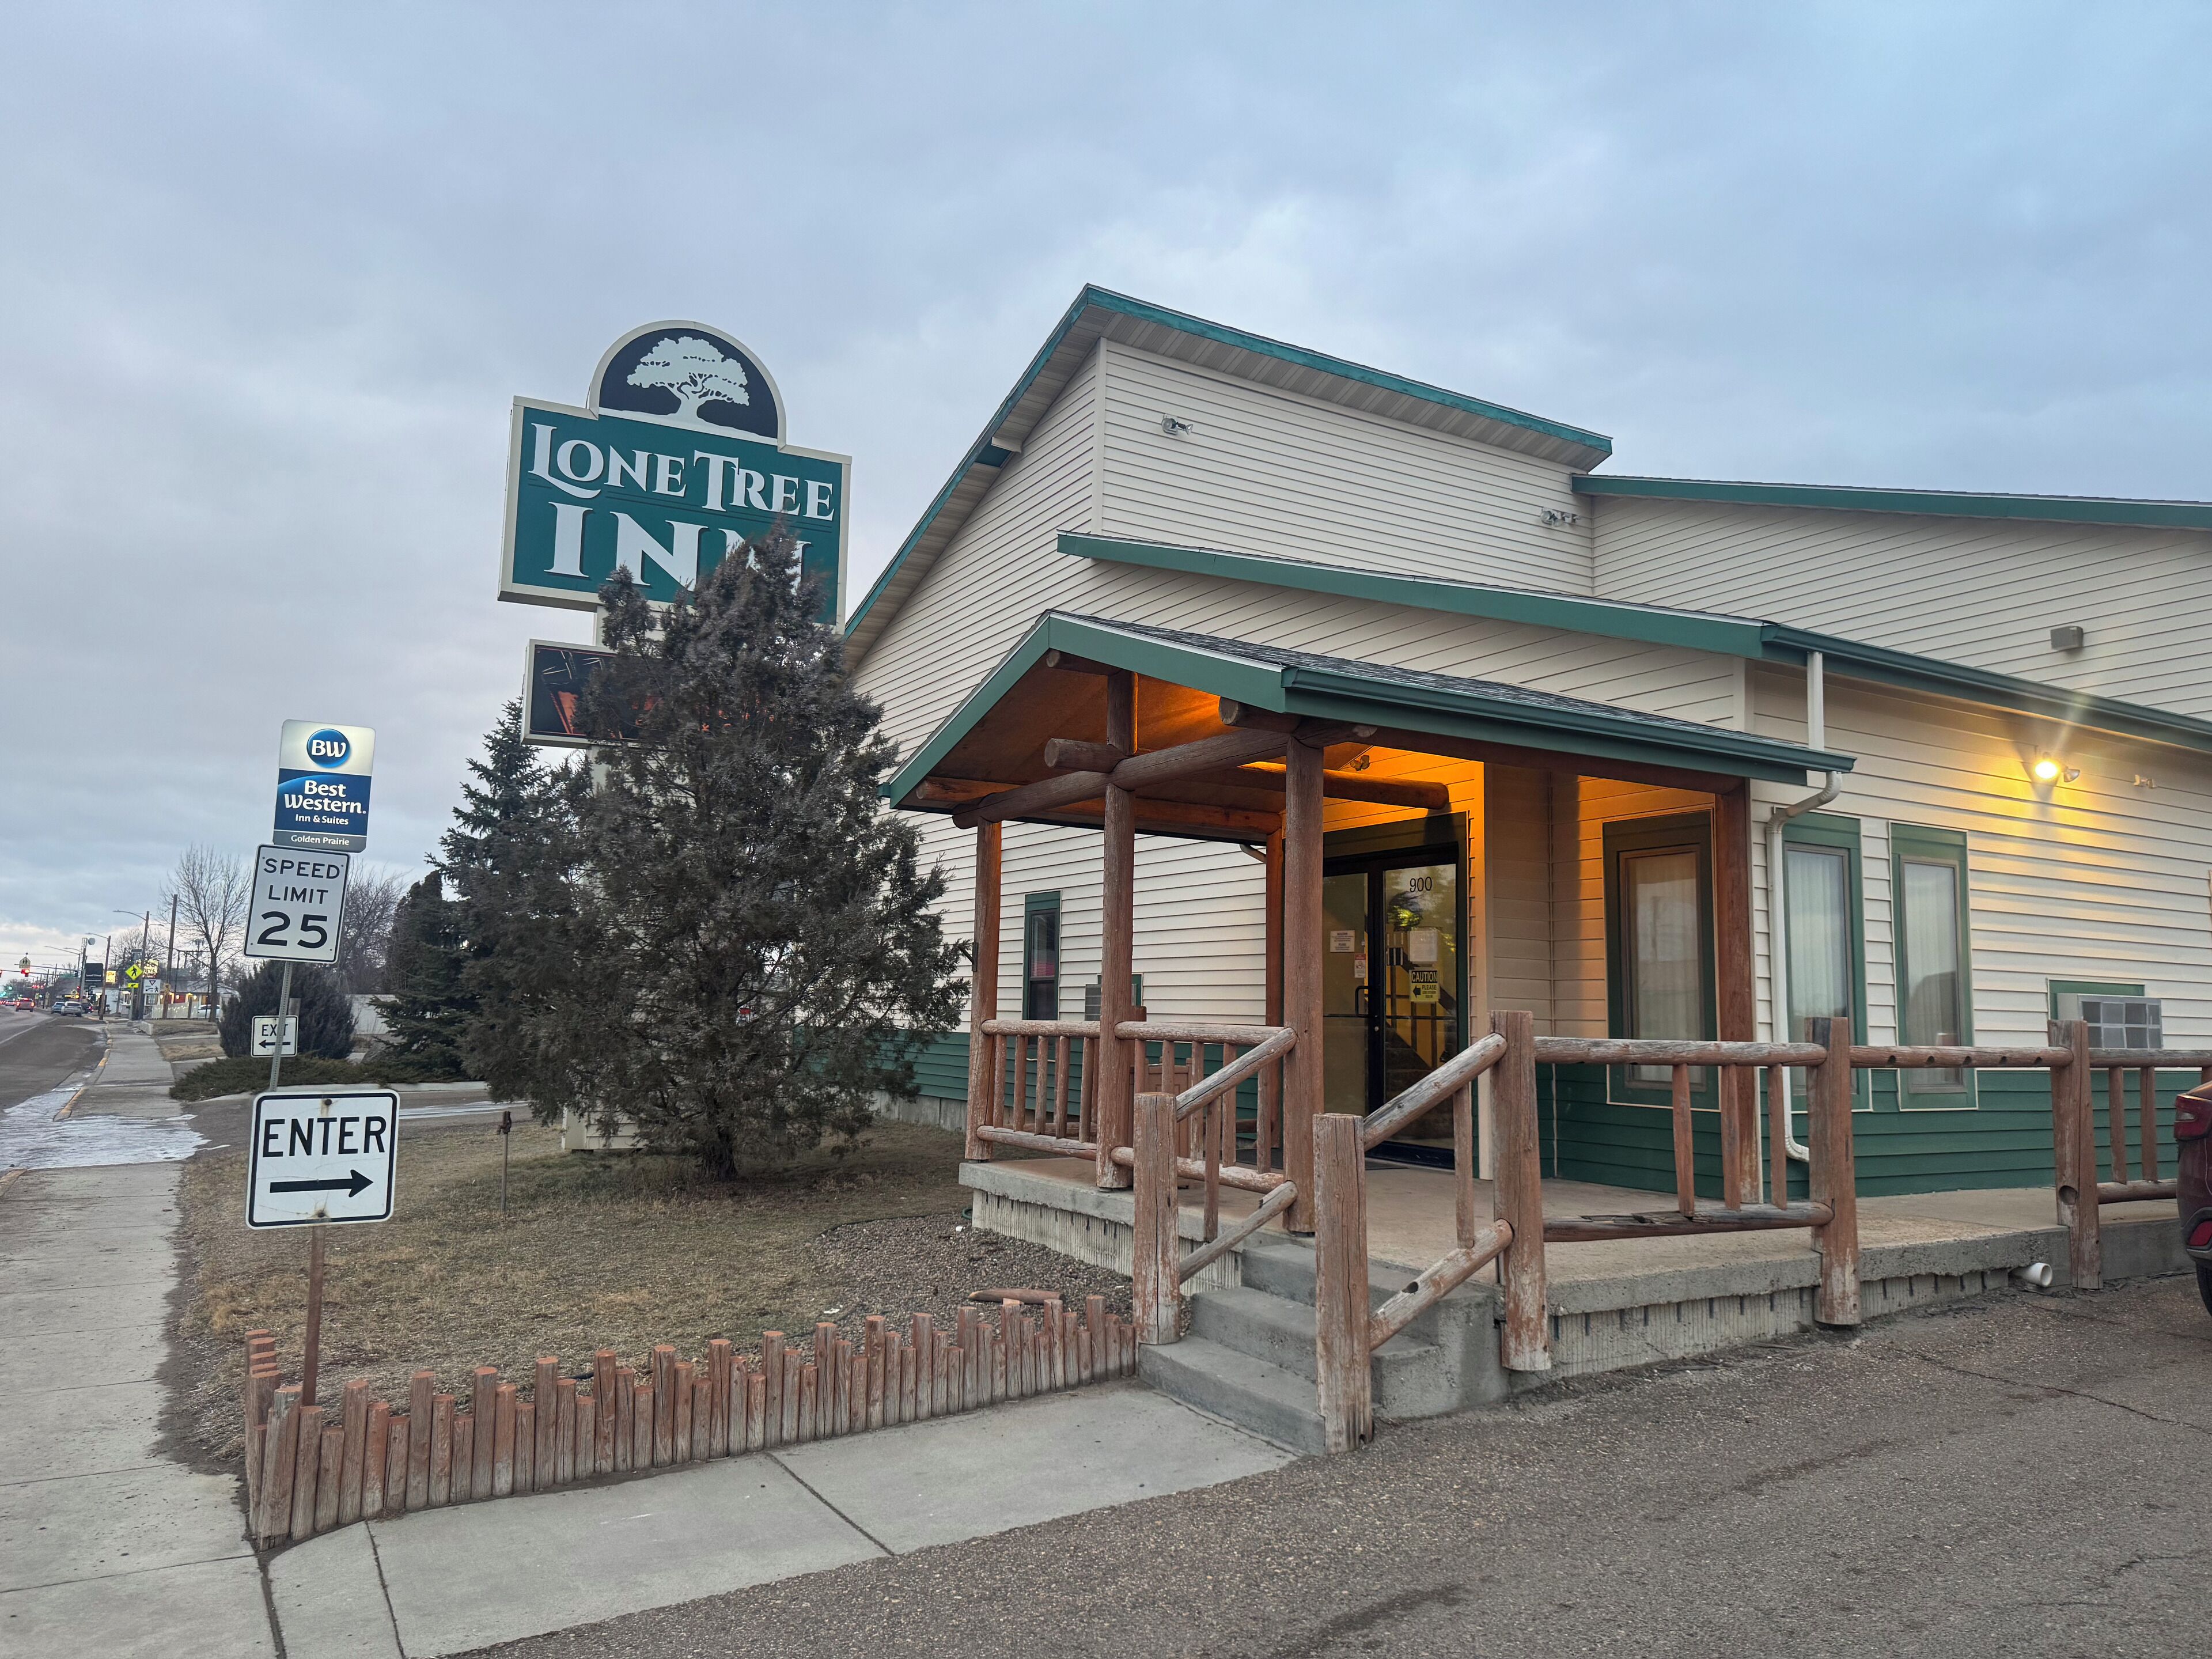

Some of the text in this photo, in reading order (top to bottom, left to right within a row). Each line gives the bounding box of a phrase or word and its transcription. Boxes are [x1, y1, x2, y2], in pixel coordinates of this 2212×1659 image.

[528, 423, 835, 521] LONE TREE
[311, 740, 346, 757] BW
[304, 779, 346, 797] Best
[284, 793, 362, 814] Western
[296, 813, 349, 825] Inn & Suites
[290, 835, 350, 846] Golden Prairie
[263, 858, 340, 879] SPEED
[1410, 876, 1432, 892] 900
[268, 884, 329, 904] LIMIT
[257, 911, 328, 949] 25
[1411, 971, 1438, 982] CAUTION
[262, 1024, 289, 1036] EXT
[263, 1116, 387, 1157] ENTER
